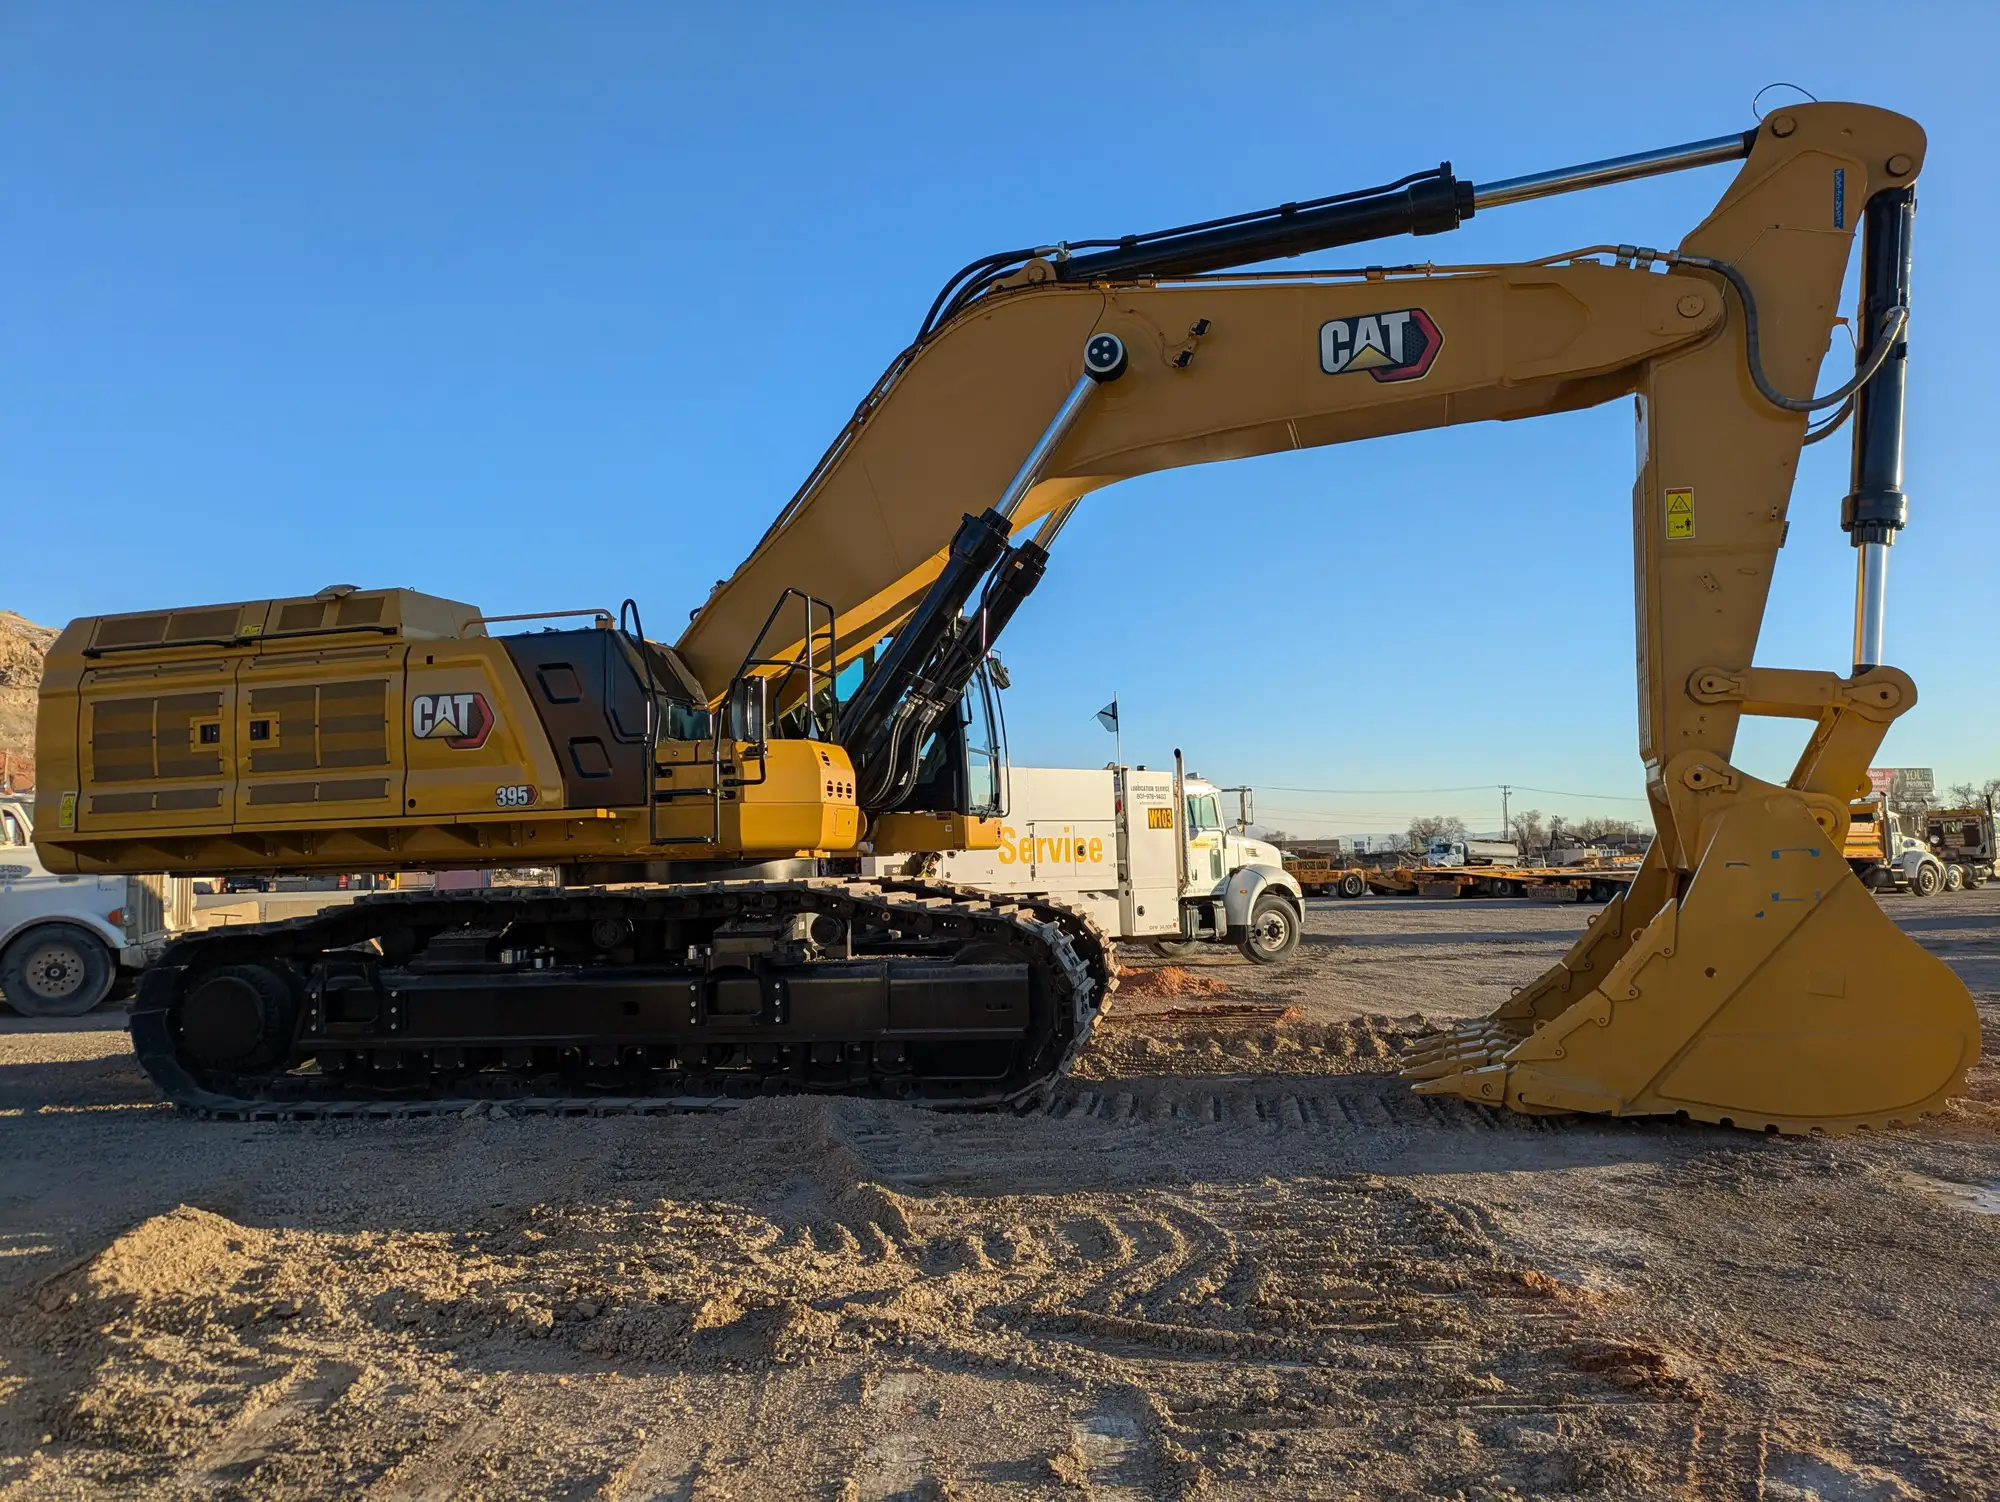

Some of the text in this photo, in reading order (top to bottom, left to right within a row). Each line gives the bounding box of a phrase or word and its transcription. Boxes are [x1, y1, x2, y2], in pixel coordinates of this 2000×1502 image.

[1321, 311, 1410, 373] CAT
[413, 694, 474, 738] CAT
[1903, 769, 1924, 780] YOU
[1905, 780, 1933, 788] PRIORITY
[496, 786, 528, 807] 395
[1148, 809, 1173, 828] W103
[998, 826, 1103, 864] Service
